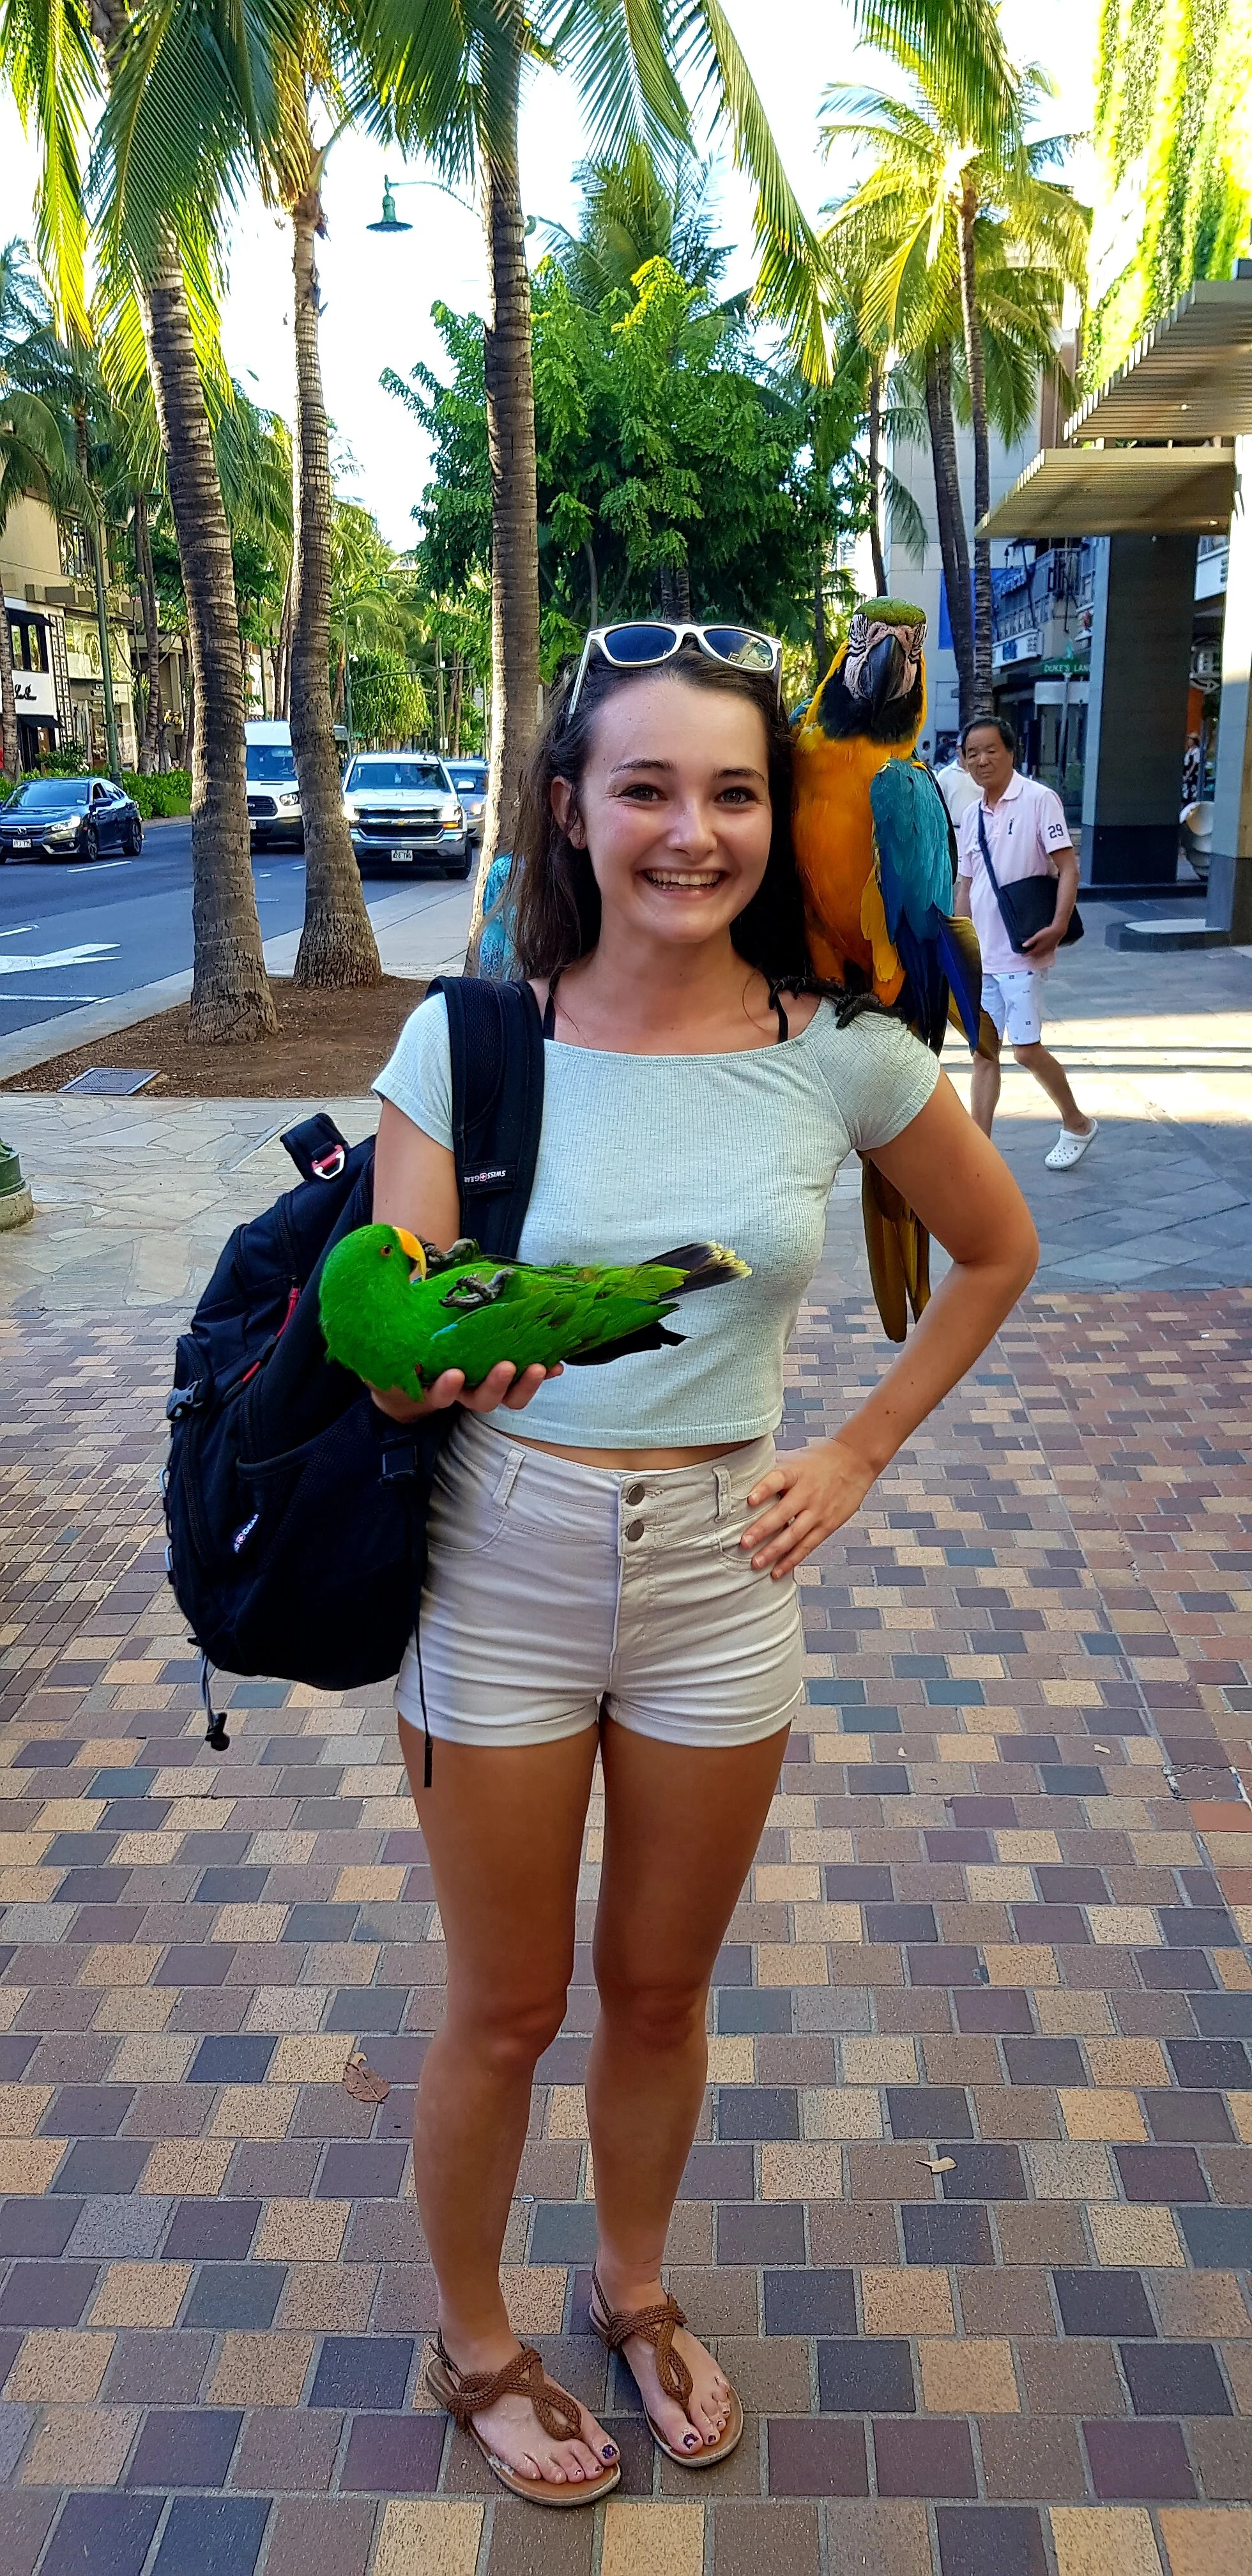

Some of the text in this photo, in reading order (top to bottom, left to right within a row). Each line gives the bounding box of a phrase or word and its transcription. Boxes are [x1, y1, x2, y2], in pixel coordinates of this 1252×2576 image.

[1043, 664, 1070, 673] DUKE'S
[1048, 824, 1064, 838] 29
[487, 1170, 507, 1179] SWISS
[242, 1514, 259, 1535] GEAR
